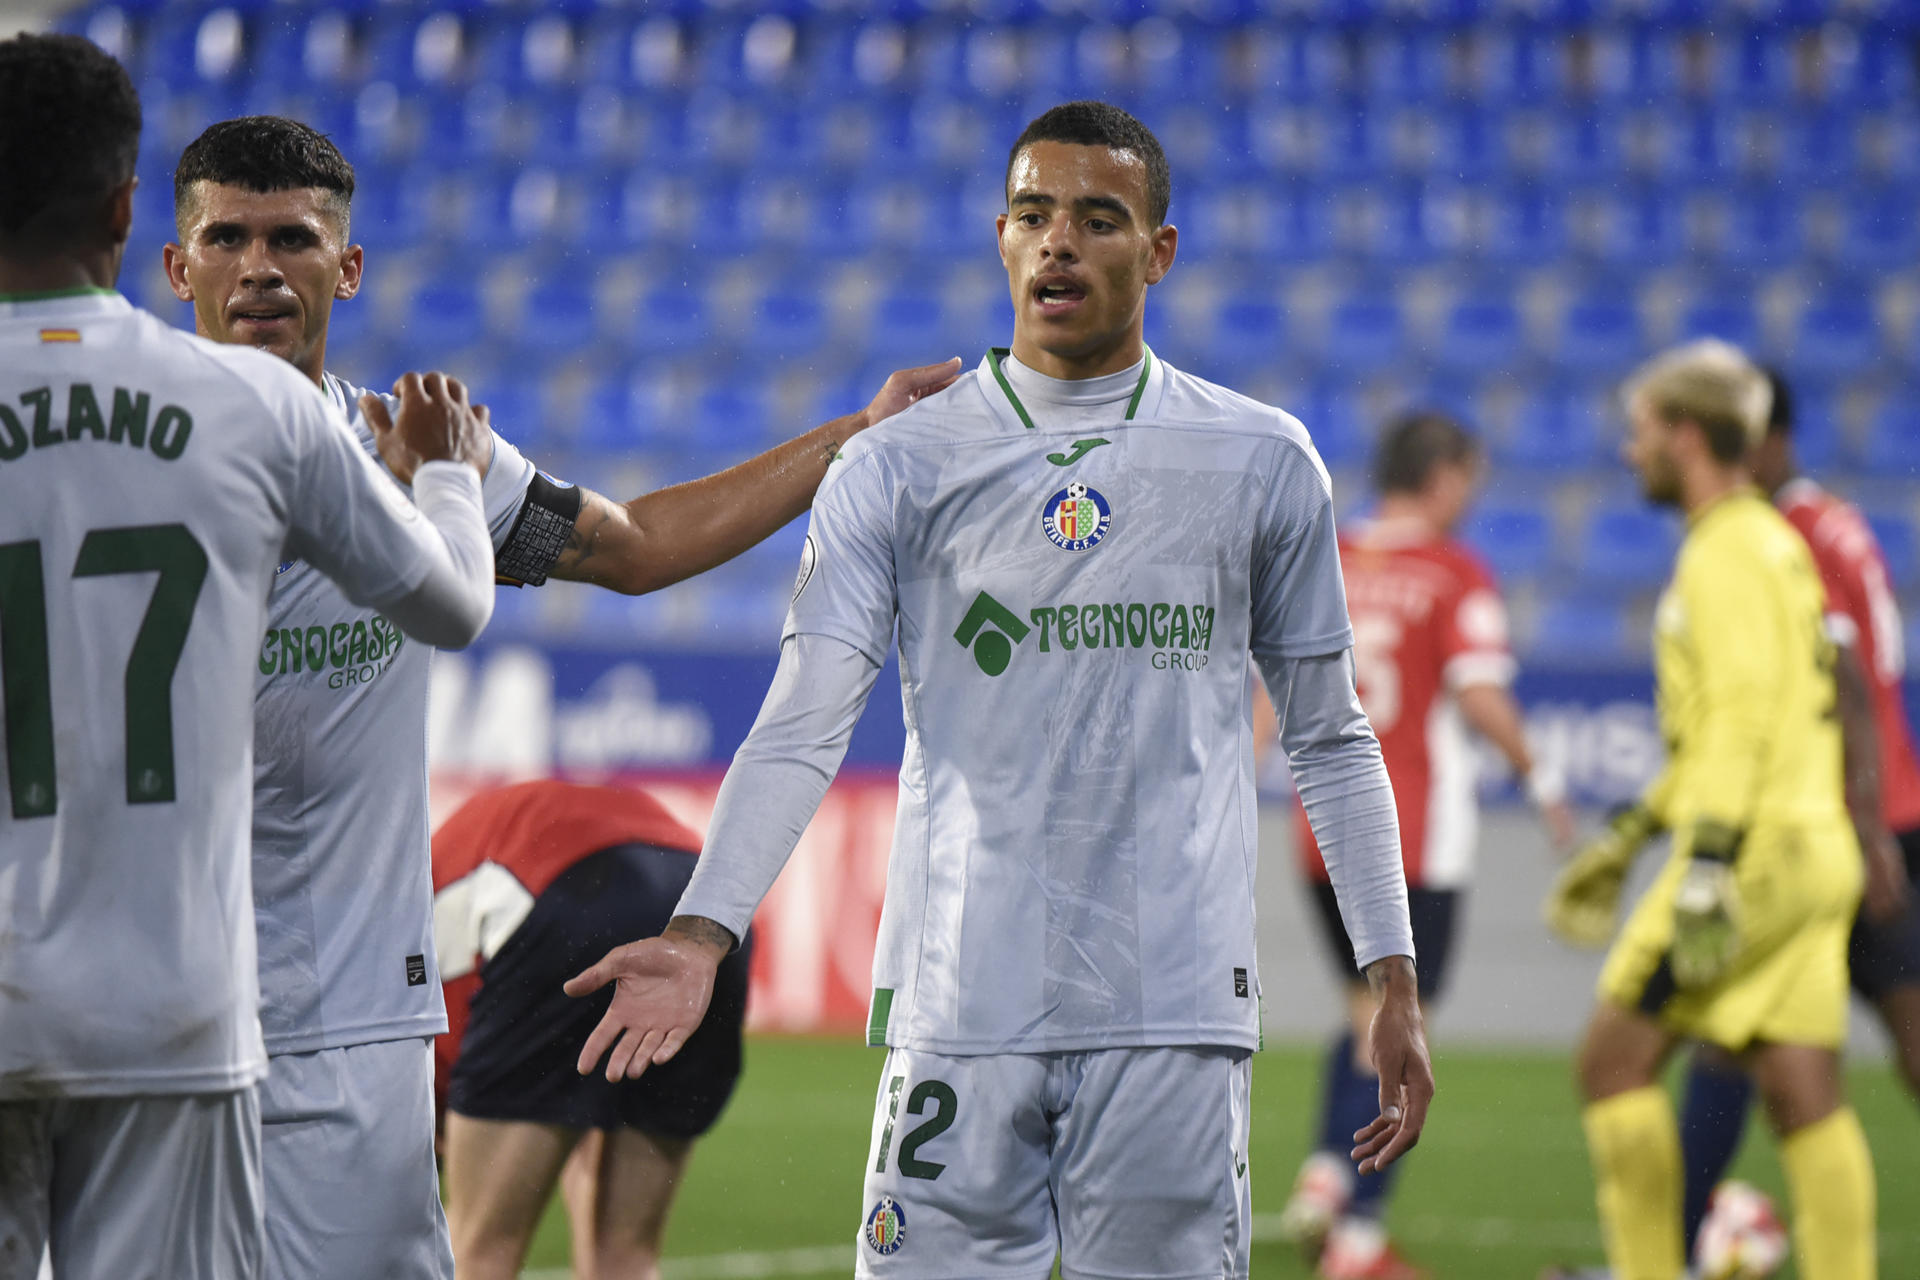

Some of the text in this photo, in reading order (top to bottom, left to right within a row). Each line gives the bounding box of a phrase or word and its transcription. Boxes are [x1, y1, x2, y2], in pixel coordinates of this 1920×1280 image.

[1043, 516, 1069, 549] GETAFE
[1073, 539, 1093, 550] C.F.
[1030, 602, 1215, 653] TECNOCASA
[0, 523, 209, 819] 17
[1151, 652, 1209, 672] GROUP
[875, 1076, 957, 1181] 12
